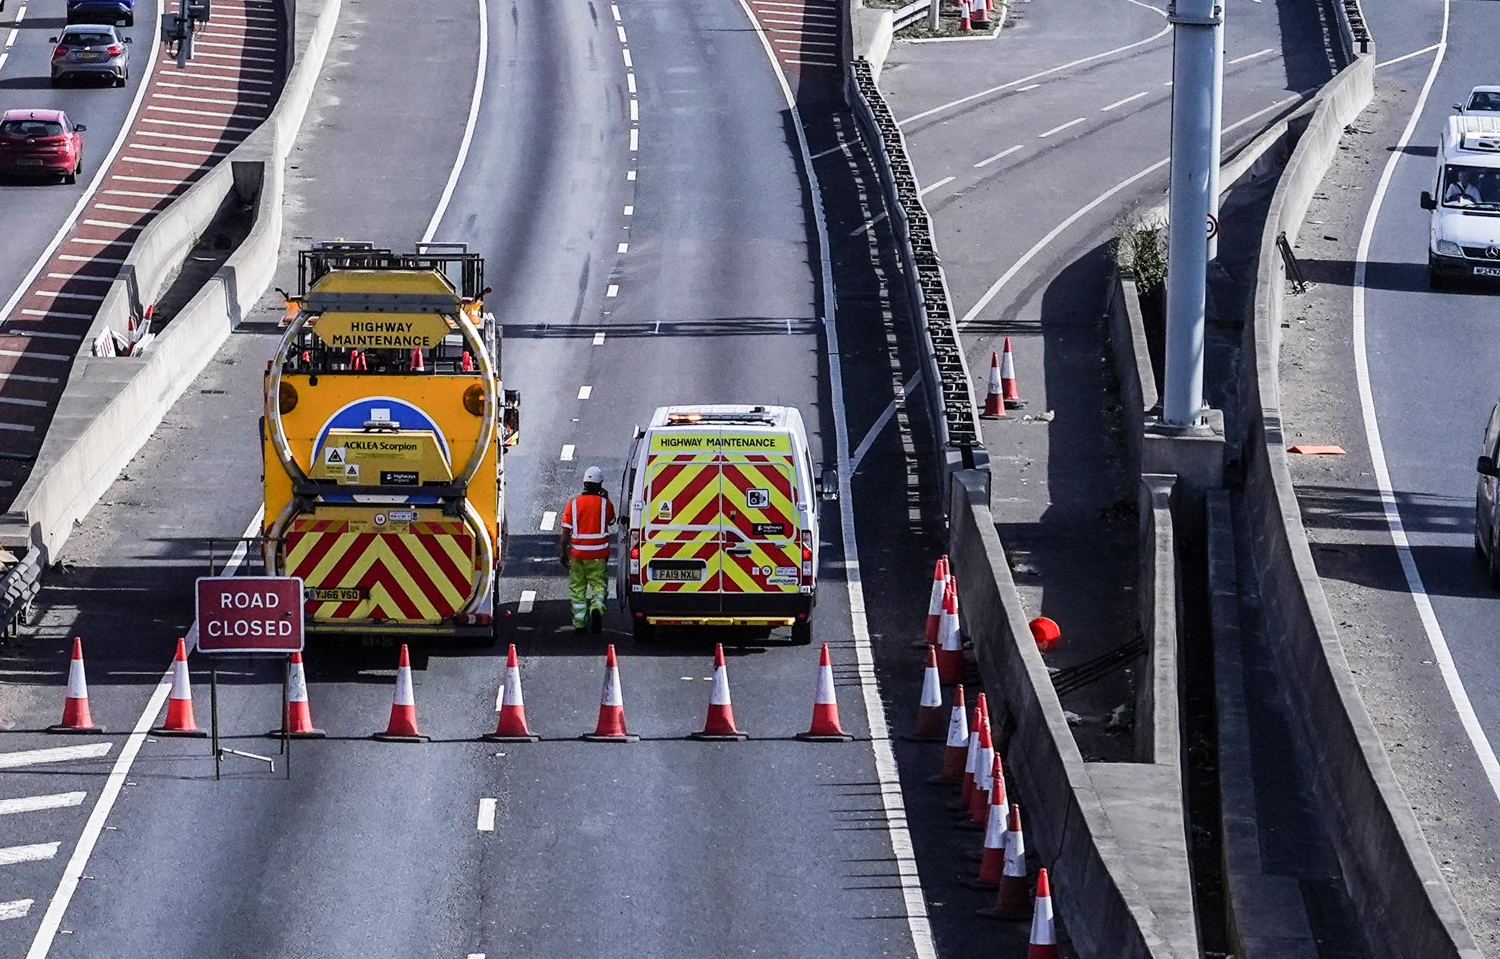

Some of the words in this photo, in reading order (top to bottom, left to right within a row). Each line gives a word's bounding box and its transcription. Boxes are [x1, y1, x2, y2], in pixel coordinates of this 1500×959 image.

[351, 322, 414, 333] HIGHWAY
[332, 335, 430, 347] MAINTENANCE
[344, 441, 378, 450] ACKLEA
[380, 442, 418, 452] Scorpion
[660, 438, 702, 447] HIGHWAY
[706, 438, 776, 447] MAINTENANCE
[660, 570, 679, 579] FA19
[680, 570, 697, 579] NXL
[220, 592, 280, 609] ROAD
[315, 591, 338, 599] YJ66
[208, 620, 292, 637] CLOSED
